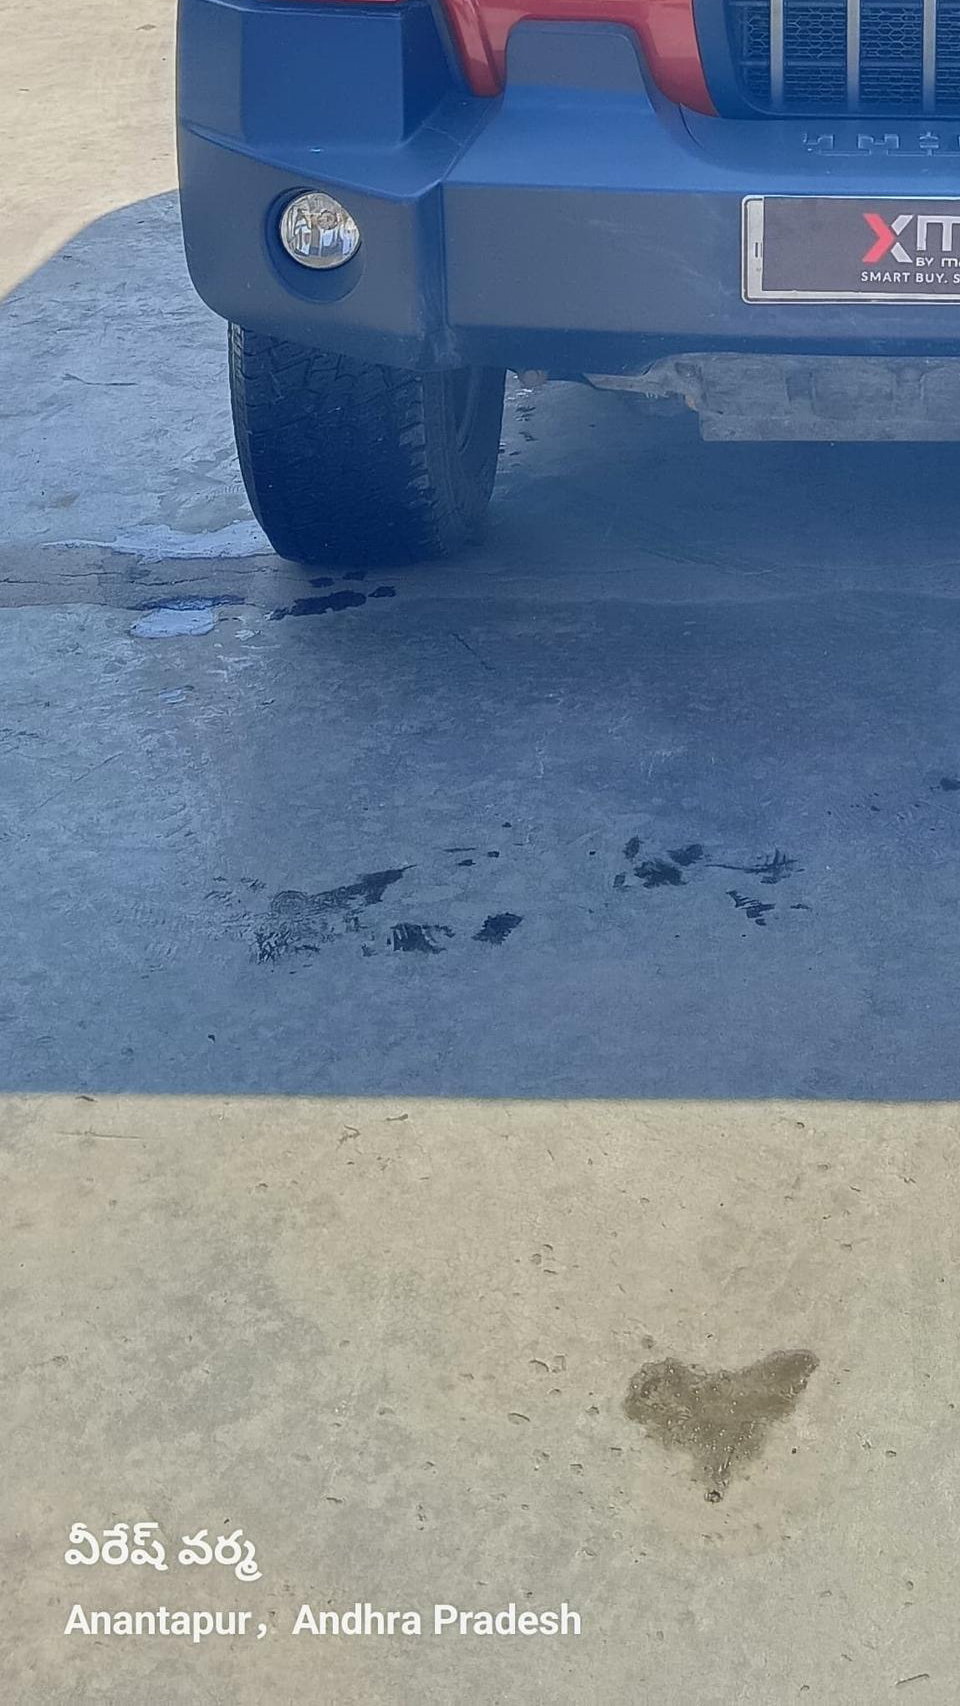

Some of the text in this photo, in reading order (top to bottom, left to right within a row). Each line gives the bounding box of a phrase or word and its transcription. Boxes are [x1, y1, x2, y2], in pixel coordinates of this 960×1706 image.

[915, 257, 934, 267] BY
[860, 271, 910, 283] SMART
[915, 273, 948, 285] BUY.
